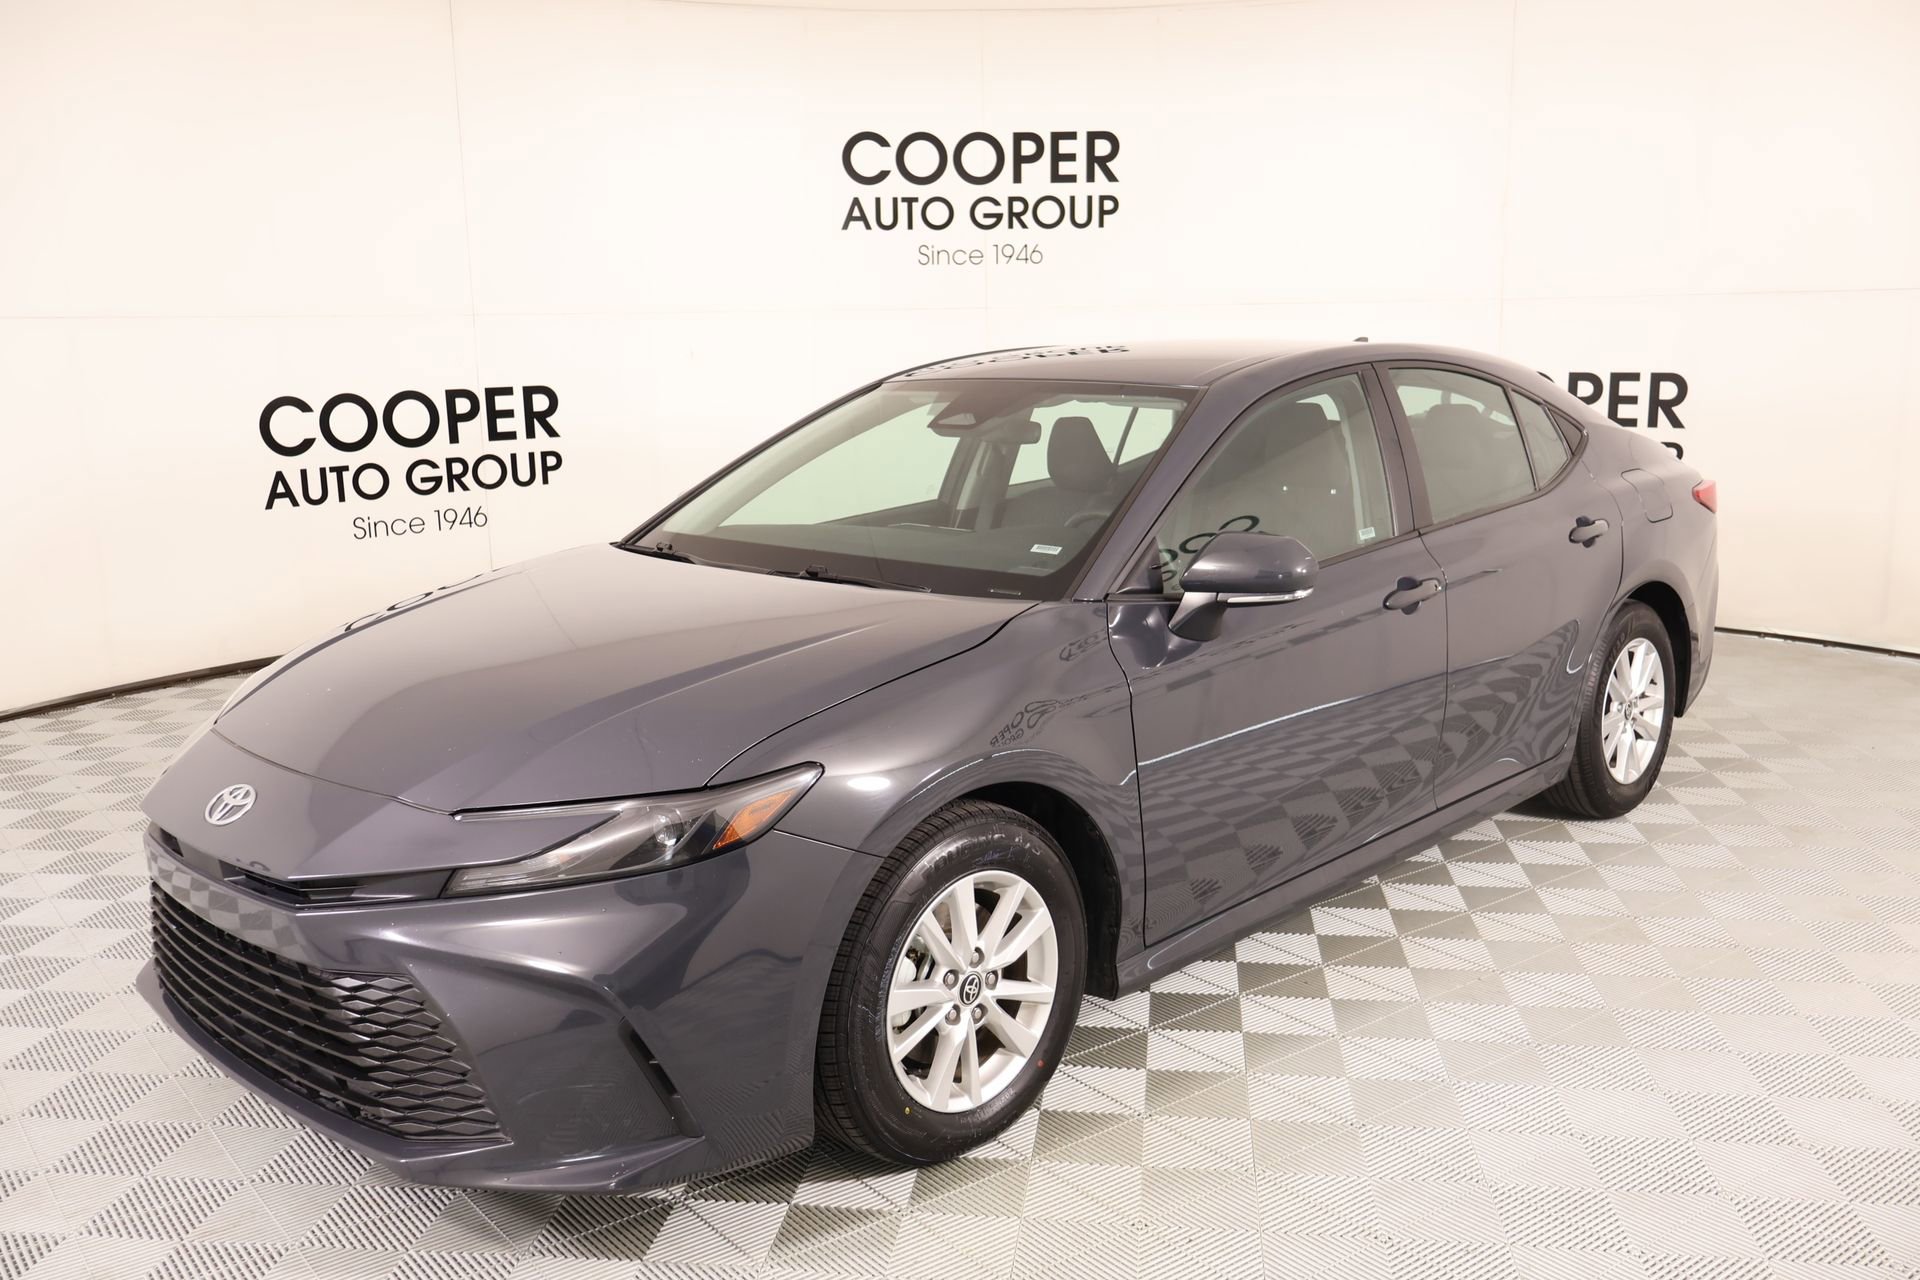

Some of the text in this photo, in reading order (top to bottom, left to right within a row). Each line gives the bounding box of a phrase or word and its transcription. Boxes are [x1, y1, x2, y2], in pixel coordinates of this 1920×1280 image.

[842, 131, 1120, 185] COOPER
[841, 195, 1119, 231] AUTO GROUP
[918, 243, 1043, 266] Since 1946
[259, 385, 561, 457] COOPER
[1537, 371, 1688, 429] PER
[265, 450, 563, 510] AUTO GROUP
[353, 505, 488, 540] Since 1946
